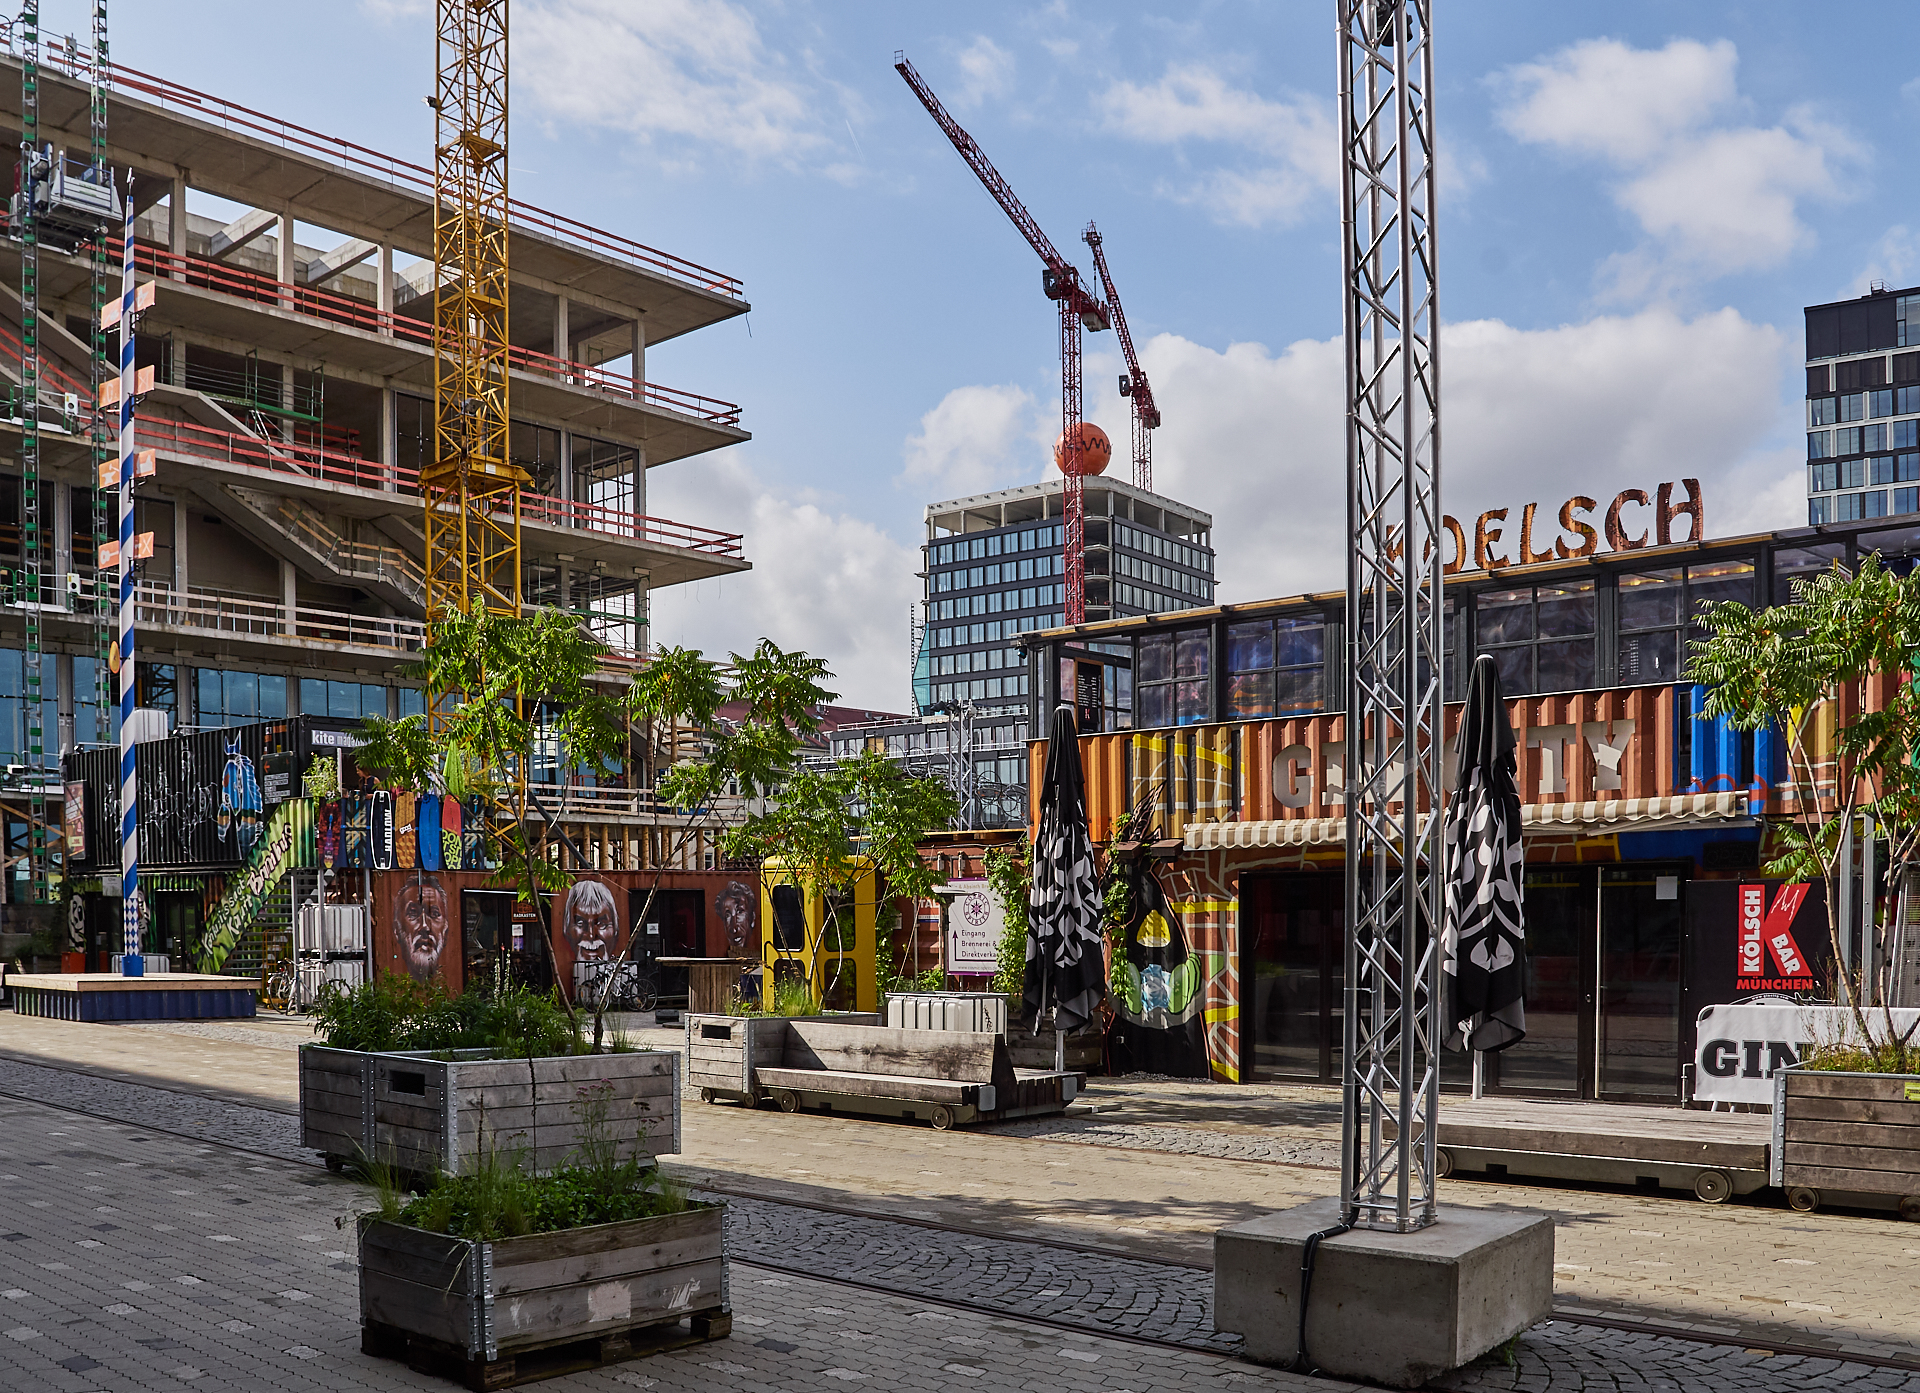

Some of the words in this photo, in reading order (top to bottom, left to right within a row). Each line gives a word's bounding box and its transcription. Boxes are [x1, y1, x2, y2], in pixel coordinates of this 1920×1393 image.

[312, 730, 335, 745] kite
[961, 929, 986, 938] Eingang
[1739, 890, 1761, 972] KÖLSCH
[961, 950, 997, 958] Direktverka
[1771, 934, 1800, 975] BAR
[1736, 976, 1813, 990] MÜNCHEN
